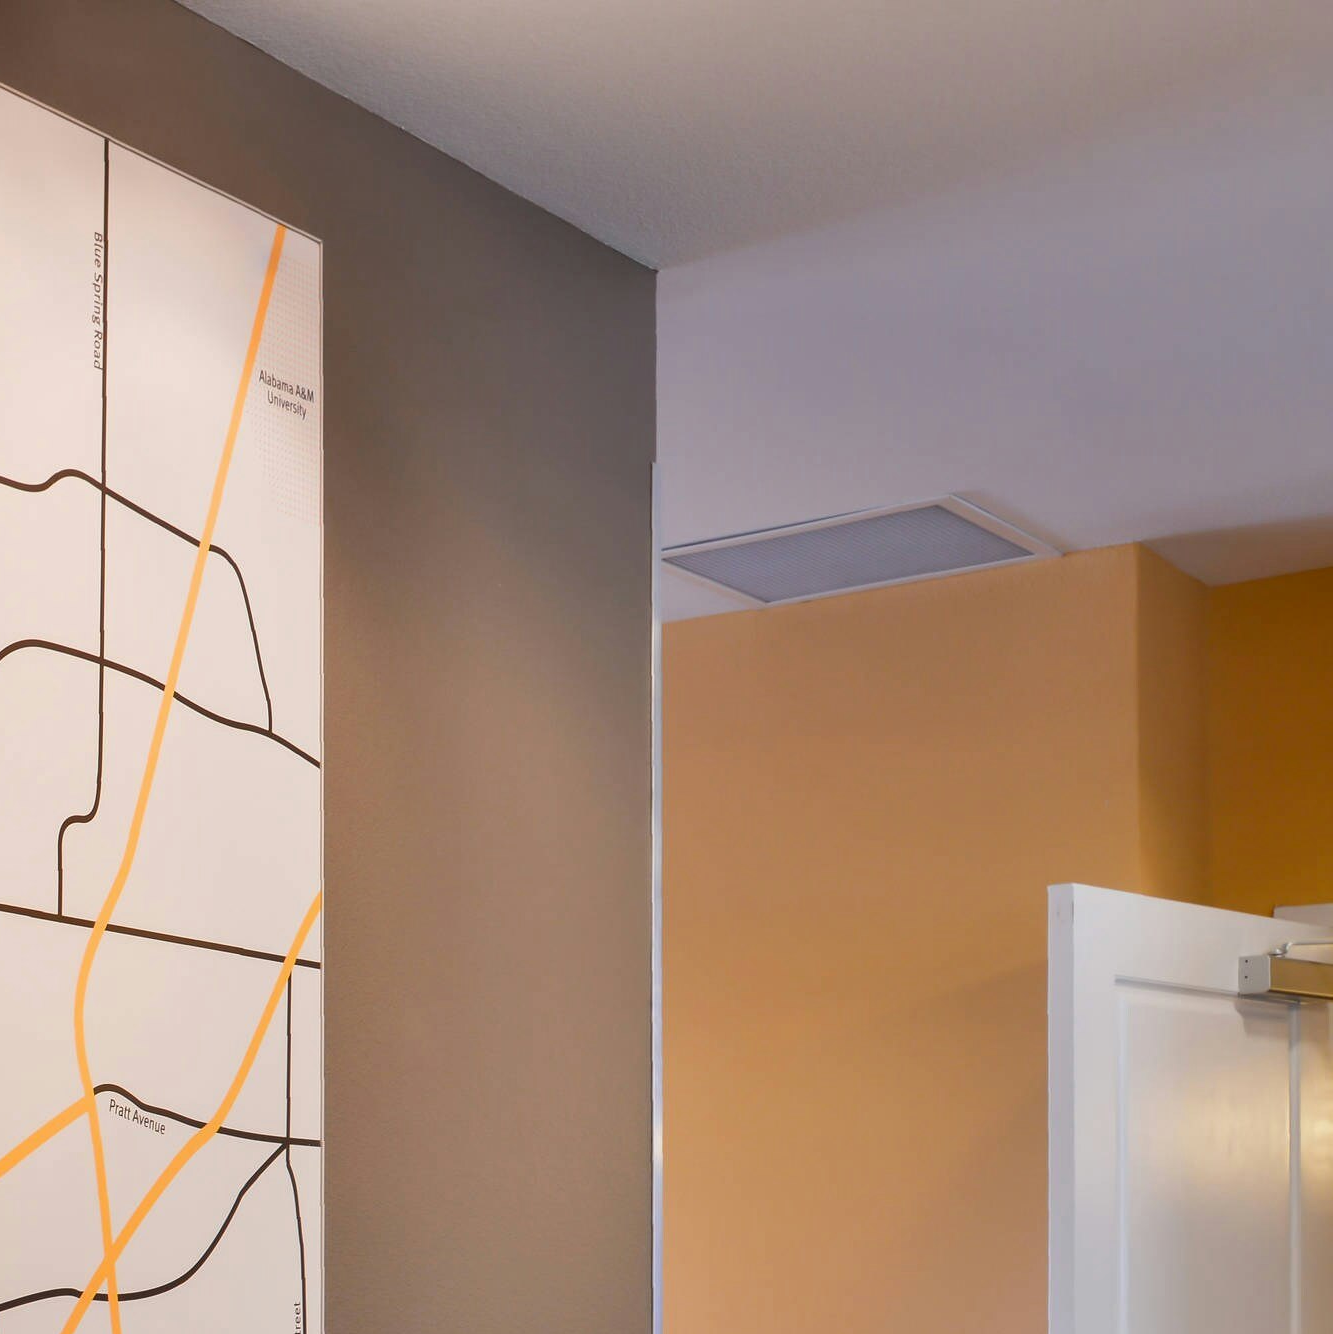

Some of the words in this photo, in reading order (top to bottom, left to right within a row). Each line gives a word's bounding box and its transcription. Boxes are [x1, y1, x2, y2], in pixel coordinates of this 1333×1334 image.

[93, 231, 103, 268] Blue
[92, 272, 103, 325] Spring
[93, 330, 103, 371] Road
[259, 369, 294, 395] Alabama
[295, 385, 315, 403] A&M
[267, 390, 307, 420] University
[109, 1098, 131, 1121] Pratt
[131, 1106, 166, 1136] Avenue
